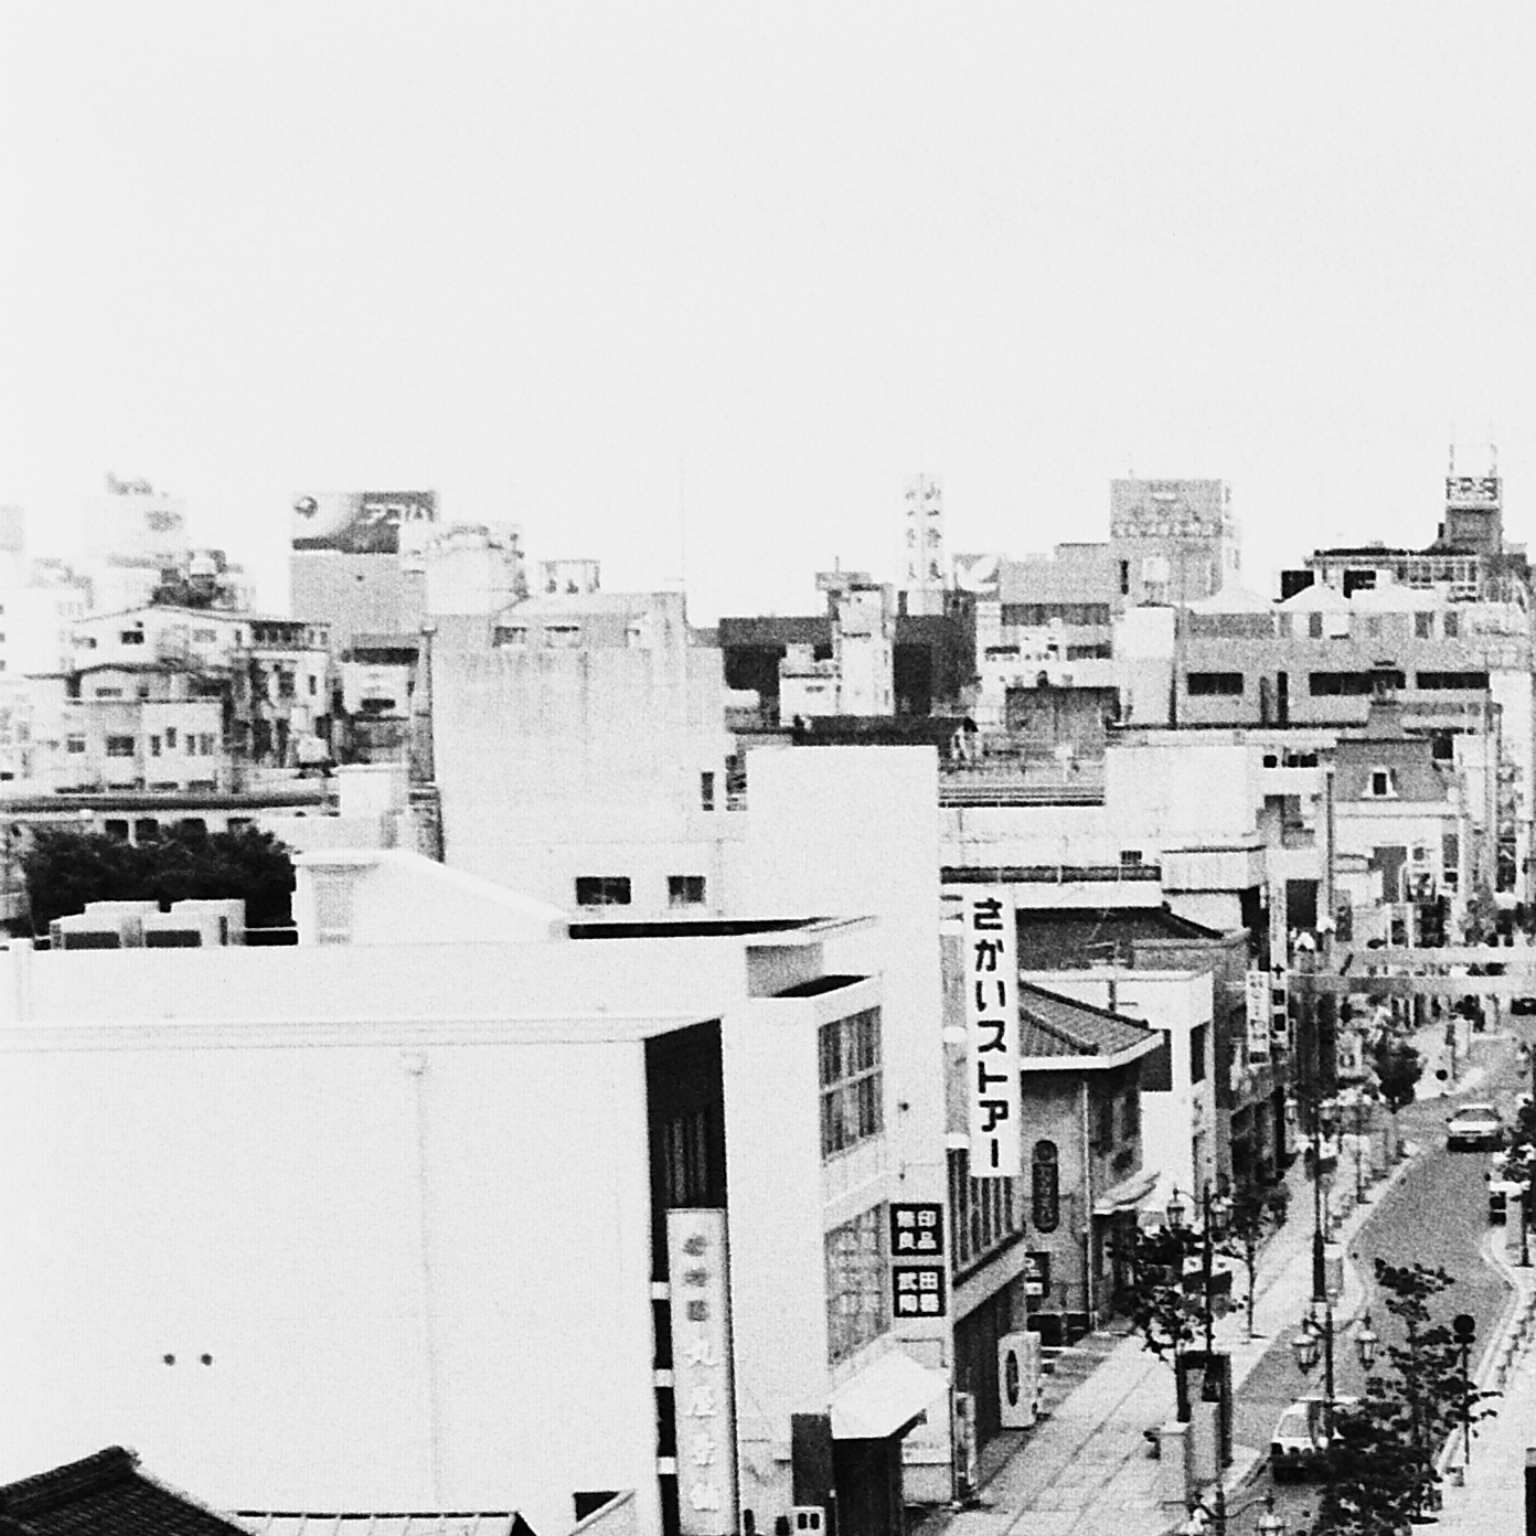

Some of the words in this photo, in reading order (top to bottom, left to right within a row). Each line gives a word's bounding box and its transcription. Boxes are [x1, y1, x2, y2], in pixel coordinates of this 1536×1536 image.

[973, 897, 1010, 1168] さかいストアー
